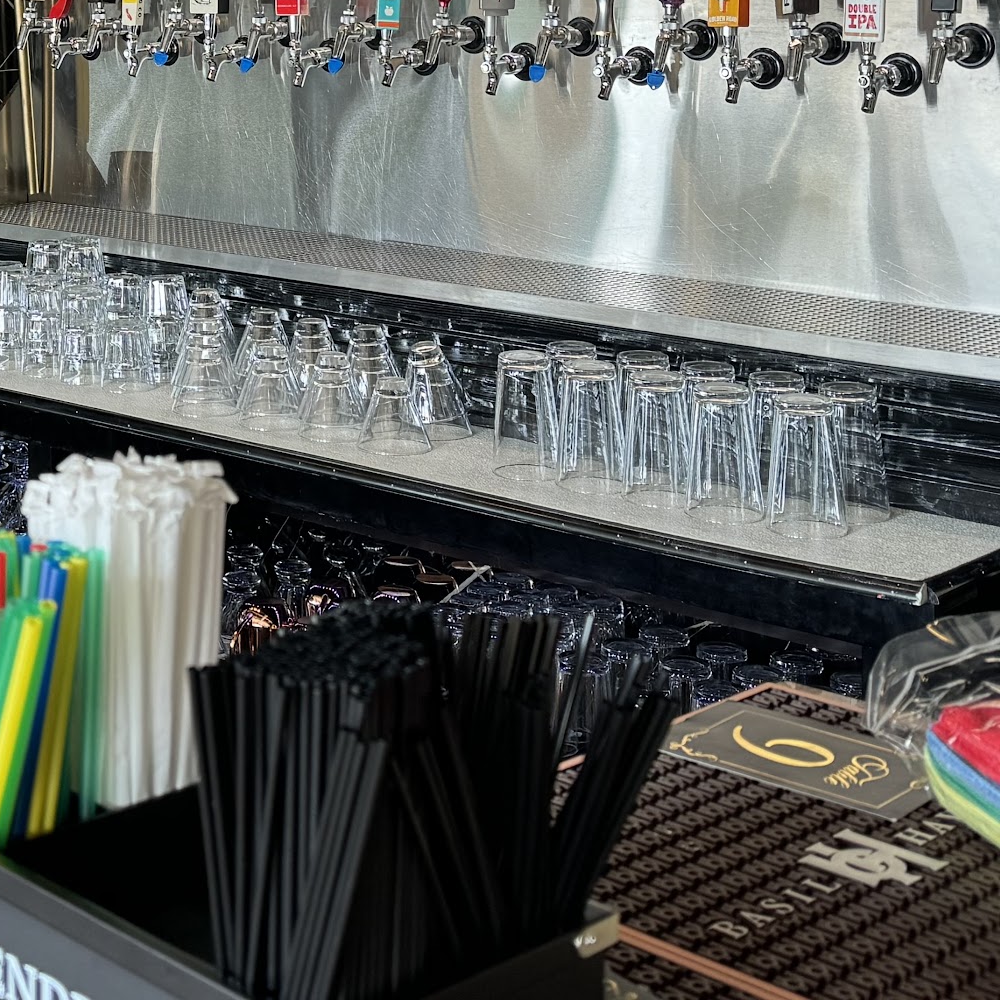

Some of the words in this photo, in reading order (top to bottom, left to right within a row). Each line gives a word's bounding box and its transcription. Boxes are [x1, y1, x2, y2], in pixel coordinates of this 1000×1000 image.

[848, 3, 877, 13] DOUBLE
[848, 15, 877, 30] IPA
[708, 878, 842, 941] BASIL
